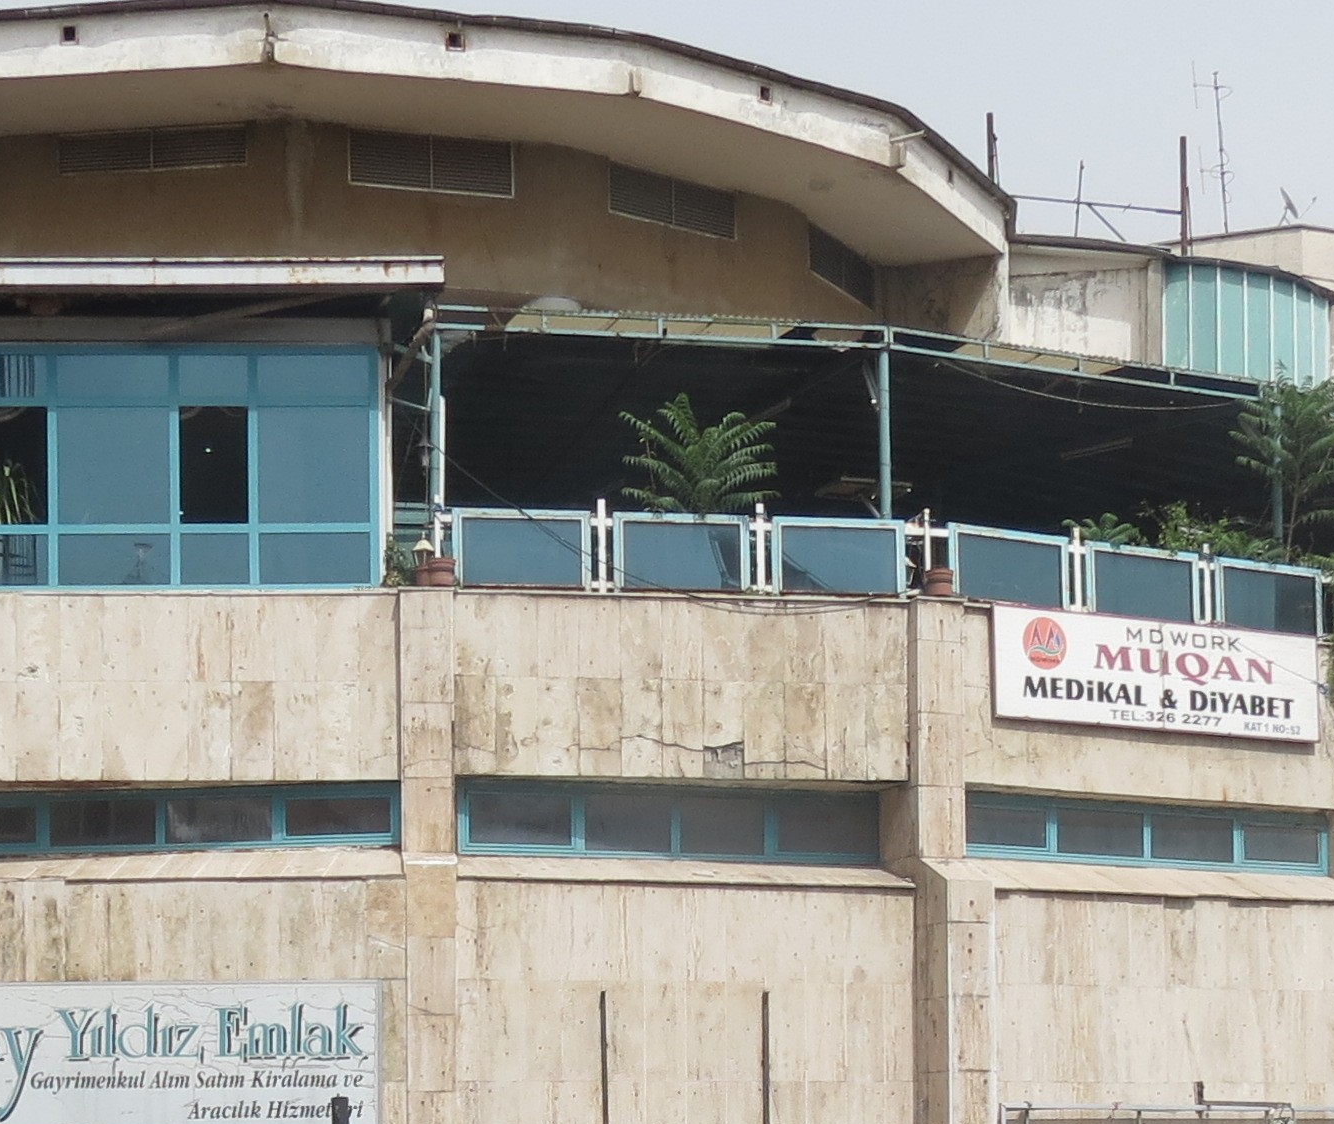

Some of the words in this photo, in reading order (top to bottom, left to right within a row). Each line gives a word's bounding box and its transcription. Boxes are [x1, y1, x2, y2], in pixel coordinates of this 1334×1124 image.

[1093, 643, 1275, 686] MUQAN
[1159, 688, 1179, 709] &
[1109, 709, 1177, 723] TEL:326
[1182, 713, 1222, 727] 2277
[1243, 722, 1263, 732] KAT
[54, 1004, 205, 1062] Yıldız
[215, 1002, 368, 1062] Emlak
[29, 1070, 145, 1094] Gayrimenkul
[149, 1070, 190, 1089] Alım
[195, 1071, 244, 1089] Satım
[250, 1071, 339, 1089] Kiralama
[343, 1074, 363, 1089] ve
[186, 1100, 262, 1119] Aracılık
[265, 1100, 364, 1119] Hizmetri
